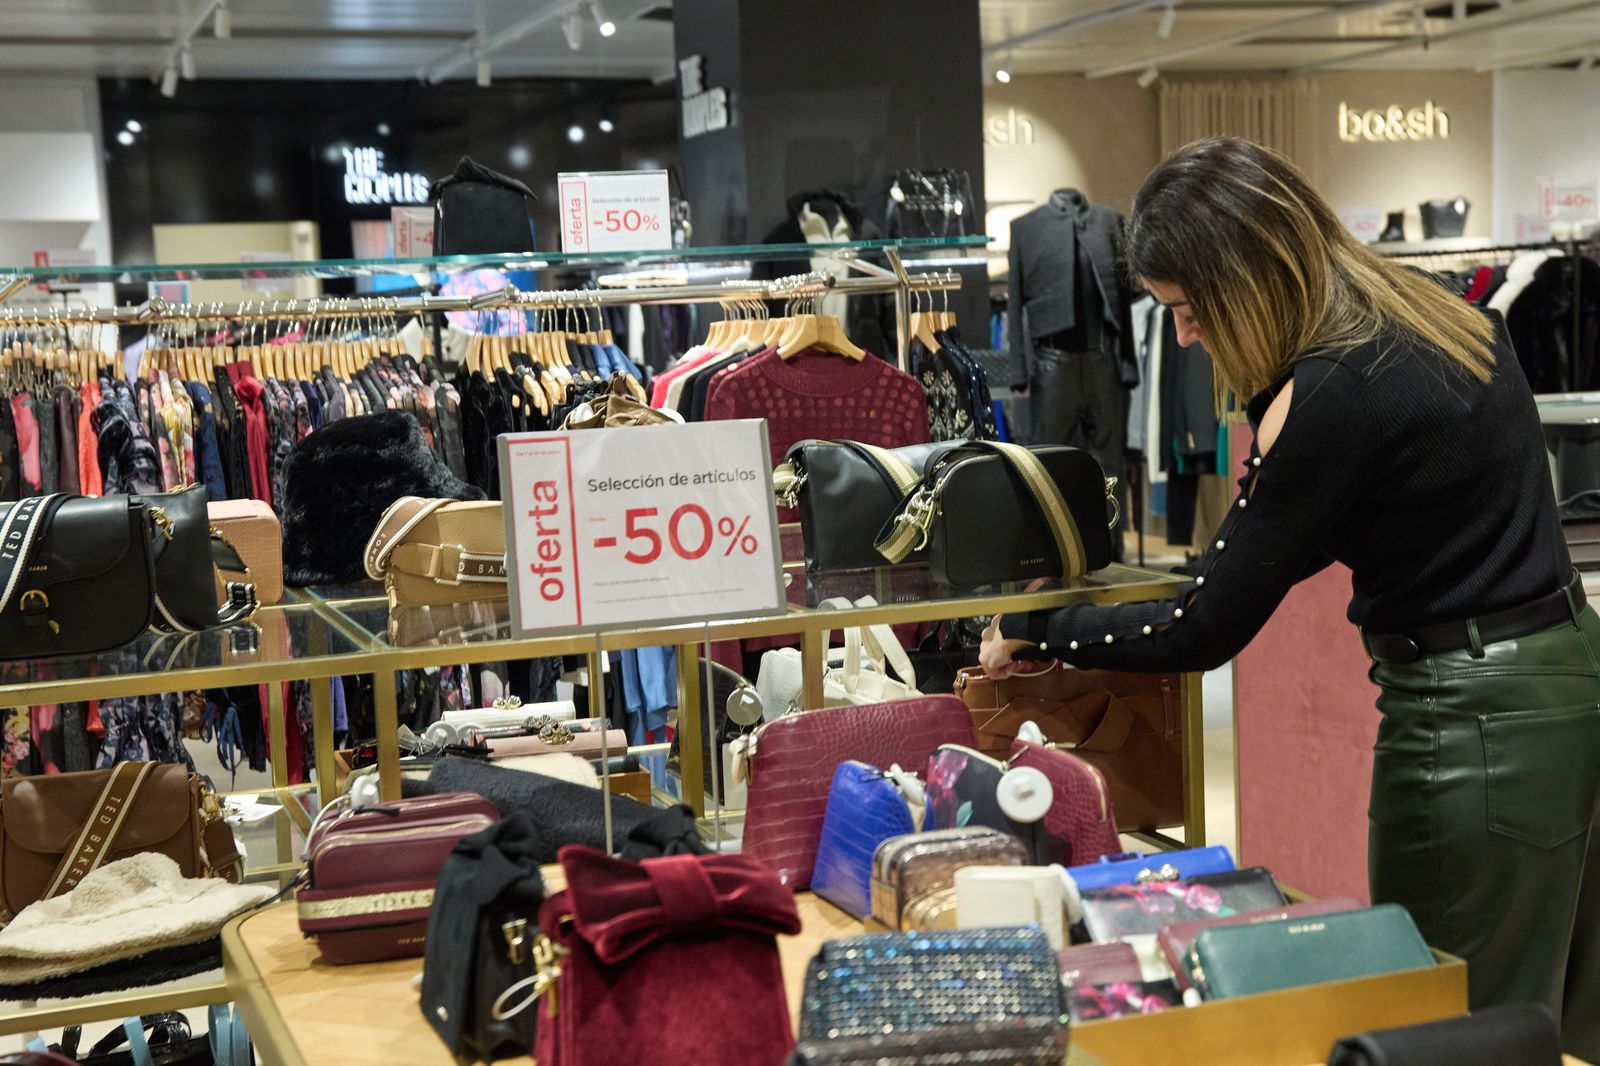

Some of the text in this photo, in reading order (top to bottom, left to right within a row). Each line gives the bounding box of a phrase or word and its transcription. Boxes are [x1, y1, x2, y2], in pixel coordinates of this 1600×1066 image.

[570, 197, 583, 245] oferta
[593, 209, 660, 232] -50%
[587, 467, 756, 492] Selección de artículos
[2, 531, 22, 559] TED
[528, 480, 564, 602] oferta
[593, 503, 758, 564] -50%
[65, 796, 121, 886] TED BAKER
